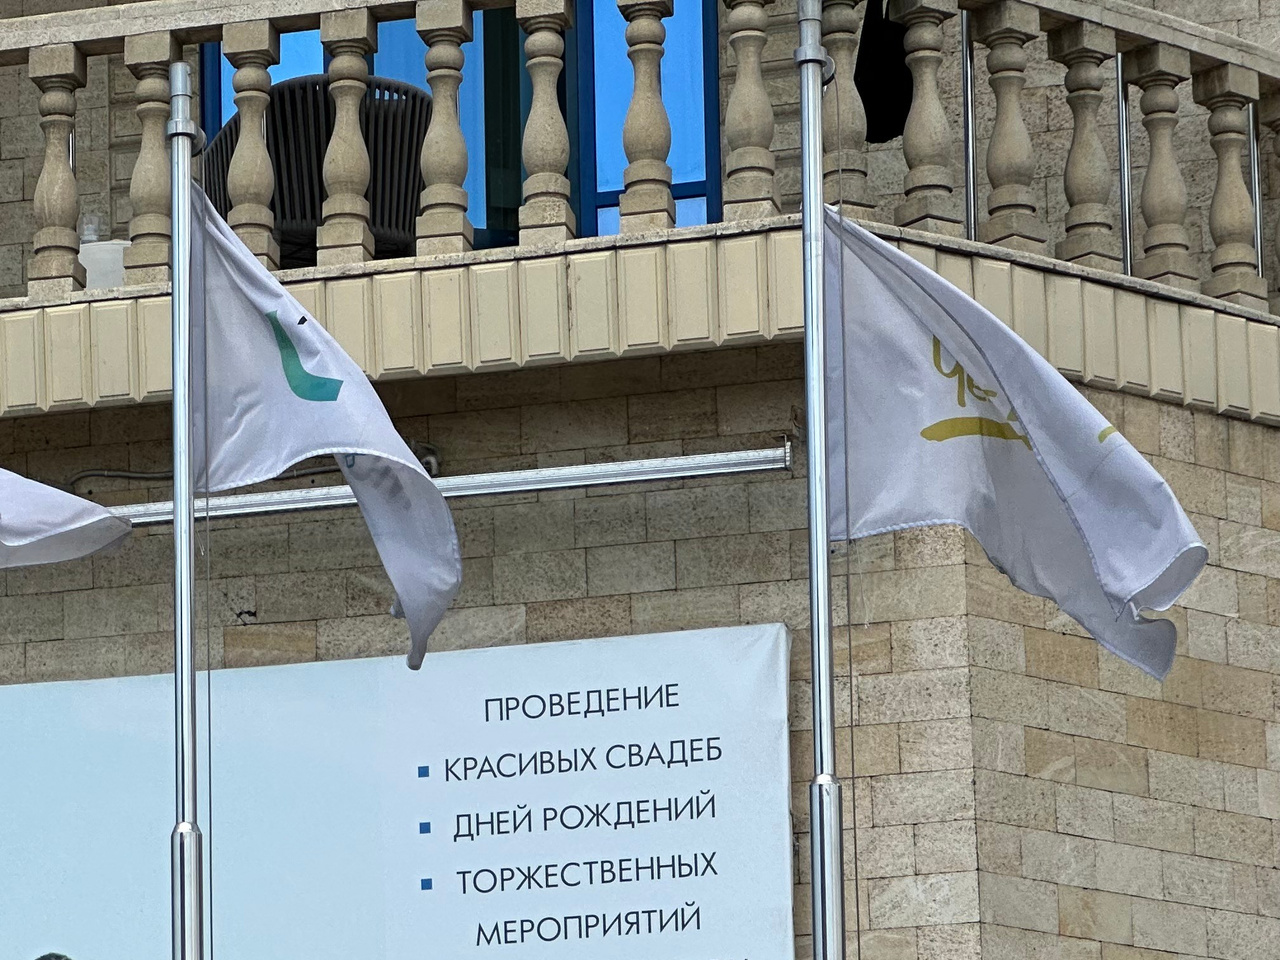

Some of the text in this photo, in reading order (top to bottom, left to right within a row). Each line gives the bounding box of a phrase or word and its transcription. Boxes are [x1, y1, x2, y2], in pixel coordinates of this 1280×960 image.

[484, 683, 680, 722] ПРОВЕДЕНИЕ
[444, 736, 723, 782] КРАСИВЫХ СВАДЕБ
[453, 789, 716, 843] ДНЕЙ РОЖДЕНИЙ
[456, 851, 719, 895] ТОРЖЕСТВЕННЫХ
[476, 900, 701, 947] МЕРОПРИЯТИЙ
